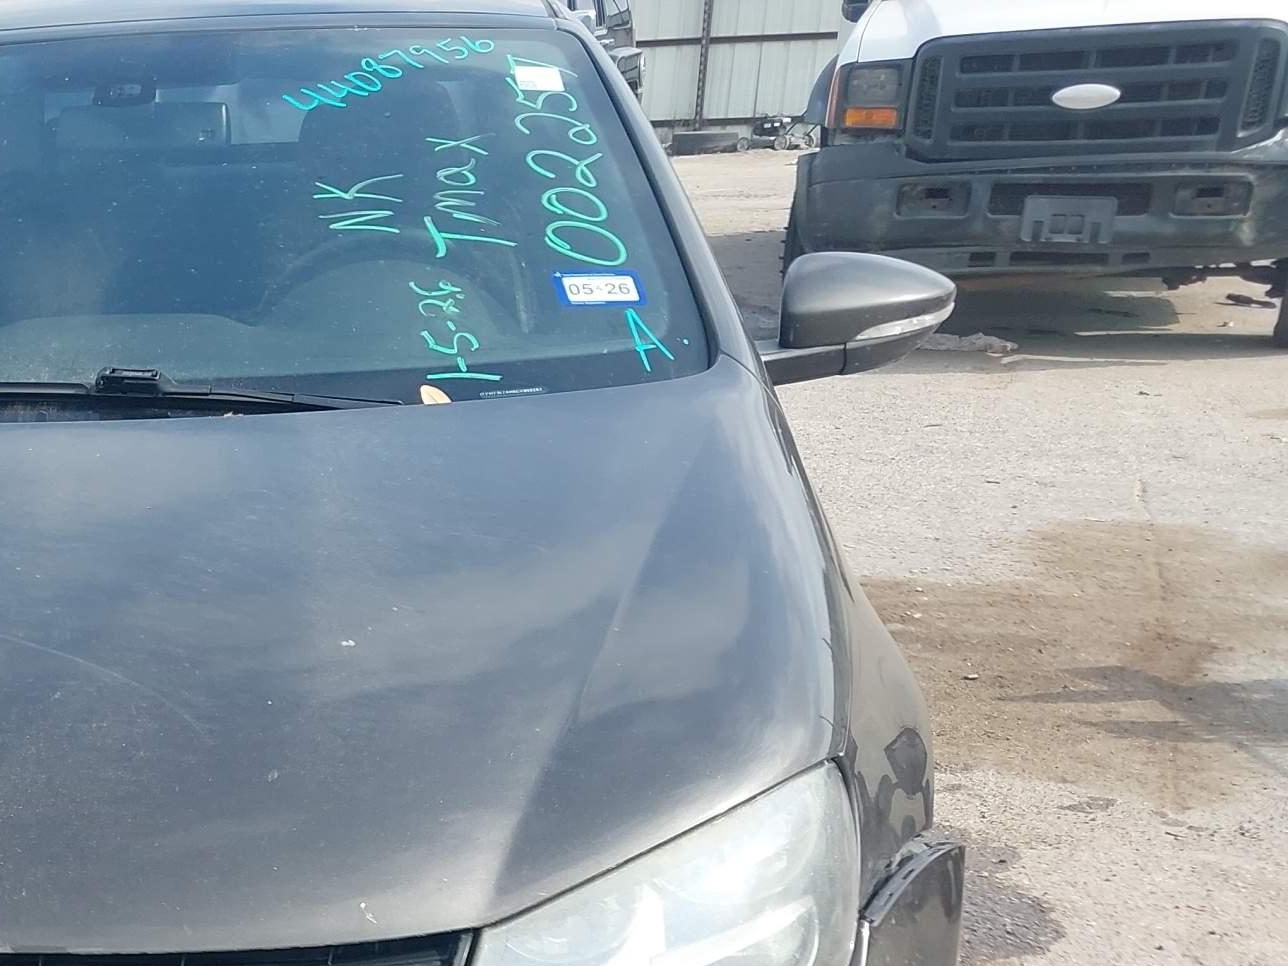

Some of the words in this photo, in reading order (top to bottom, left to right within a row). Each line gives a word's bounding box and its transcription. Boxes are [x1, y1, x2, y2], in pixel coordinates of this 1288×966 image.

[282, 35, 495, 111] 44087956
[312, 173, 404, 234] NK
[624, 307, 675, 372] A
